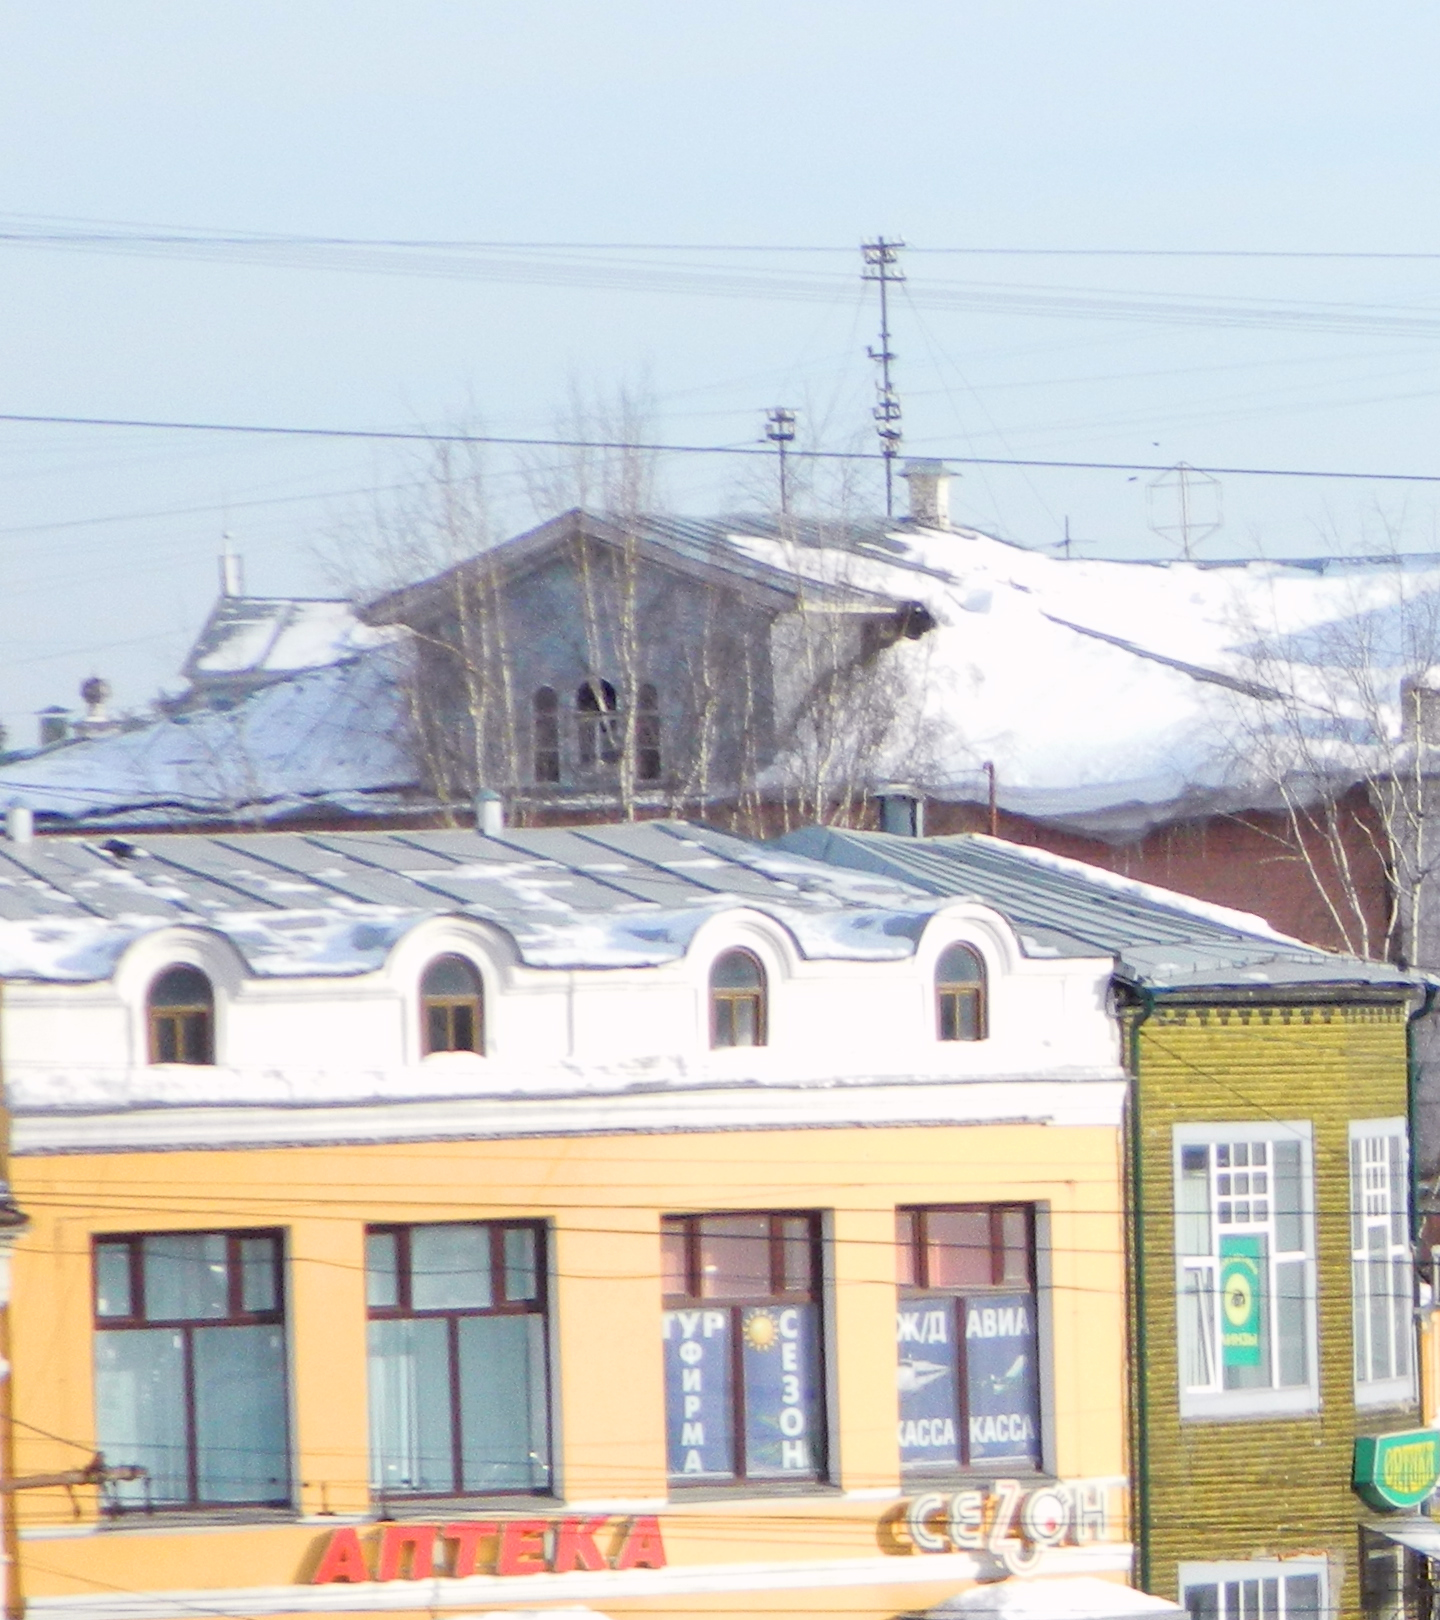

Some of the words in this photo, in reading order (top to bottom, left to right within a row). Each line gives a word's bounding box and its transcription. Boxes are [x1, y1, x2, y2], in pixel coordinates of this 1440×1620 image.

[662, 1311, 725, 1339] ТУР
[965, 1306, 1031, 1338] АВИА
[679, 1340, 705, 1473] ФИРМА
[778, 1308, 805, 1470] СЕЗОН
[969, 1413, 1035, 1443] КАССА
[311, 1515, 669, 1585] АПТЕКА
